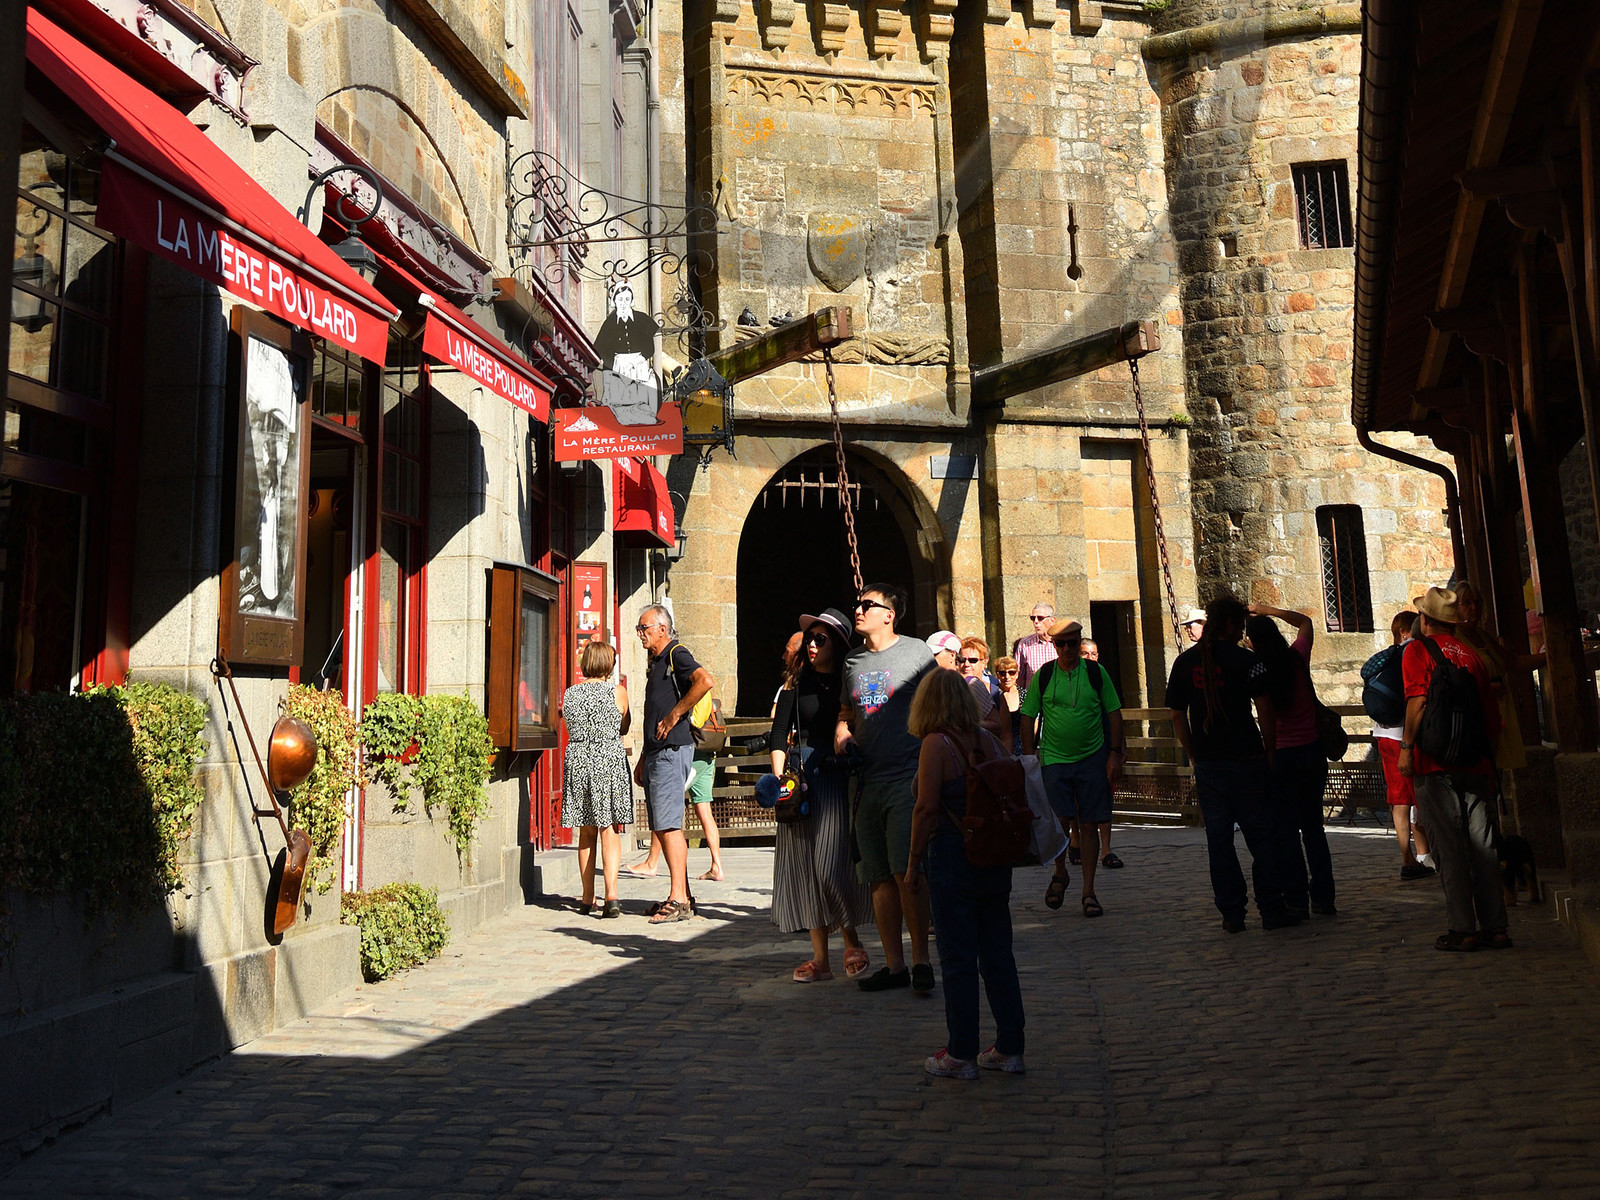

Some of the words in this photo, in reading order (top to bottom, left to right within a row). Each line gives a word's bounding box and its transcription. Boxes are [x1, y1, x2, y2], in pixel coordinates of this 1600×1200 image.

[157, 200, 191, 259] LA
[197, 221, 264, 297] MÈRE
[268, 261, 357, 344] POULARD
[447, 330, 463, 366] LA
[463, 340, 493, 384] MÈRE
[494, 361, 537, 410] POULARD
[582, 436, 616, 445] MÈRE
[620, 433, 677, 444] POULARD
[582, 443, 657, 455] RESTAURANT
[860, 694, 889, 705] KENZO
